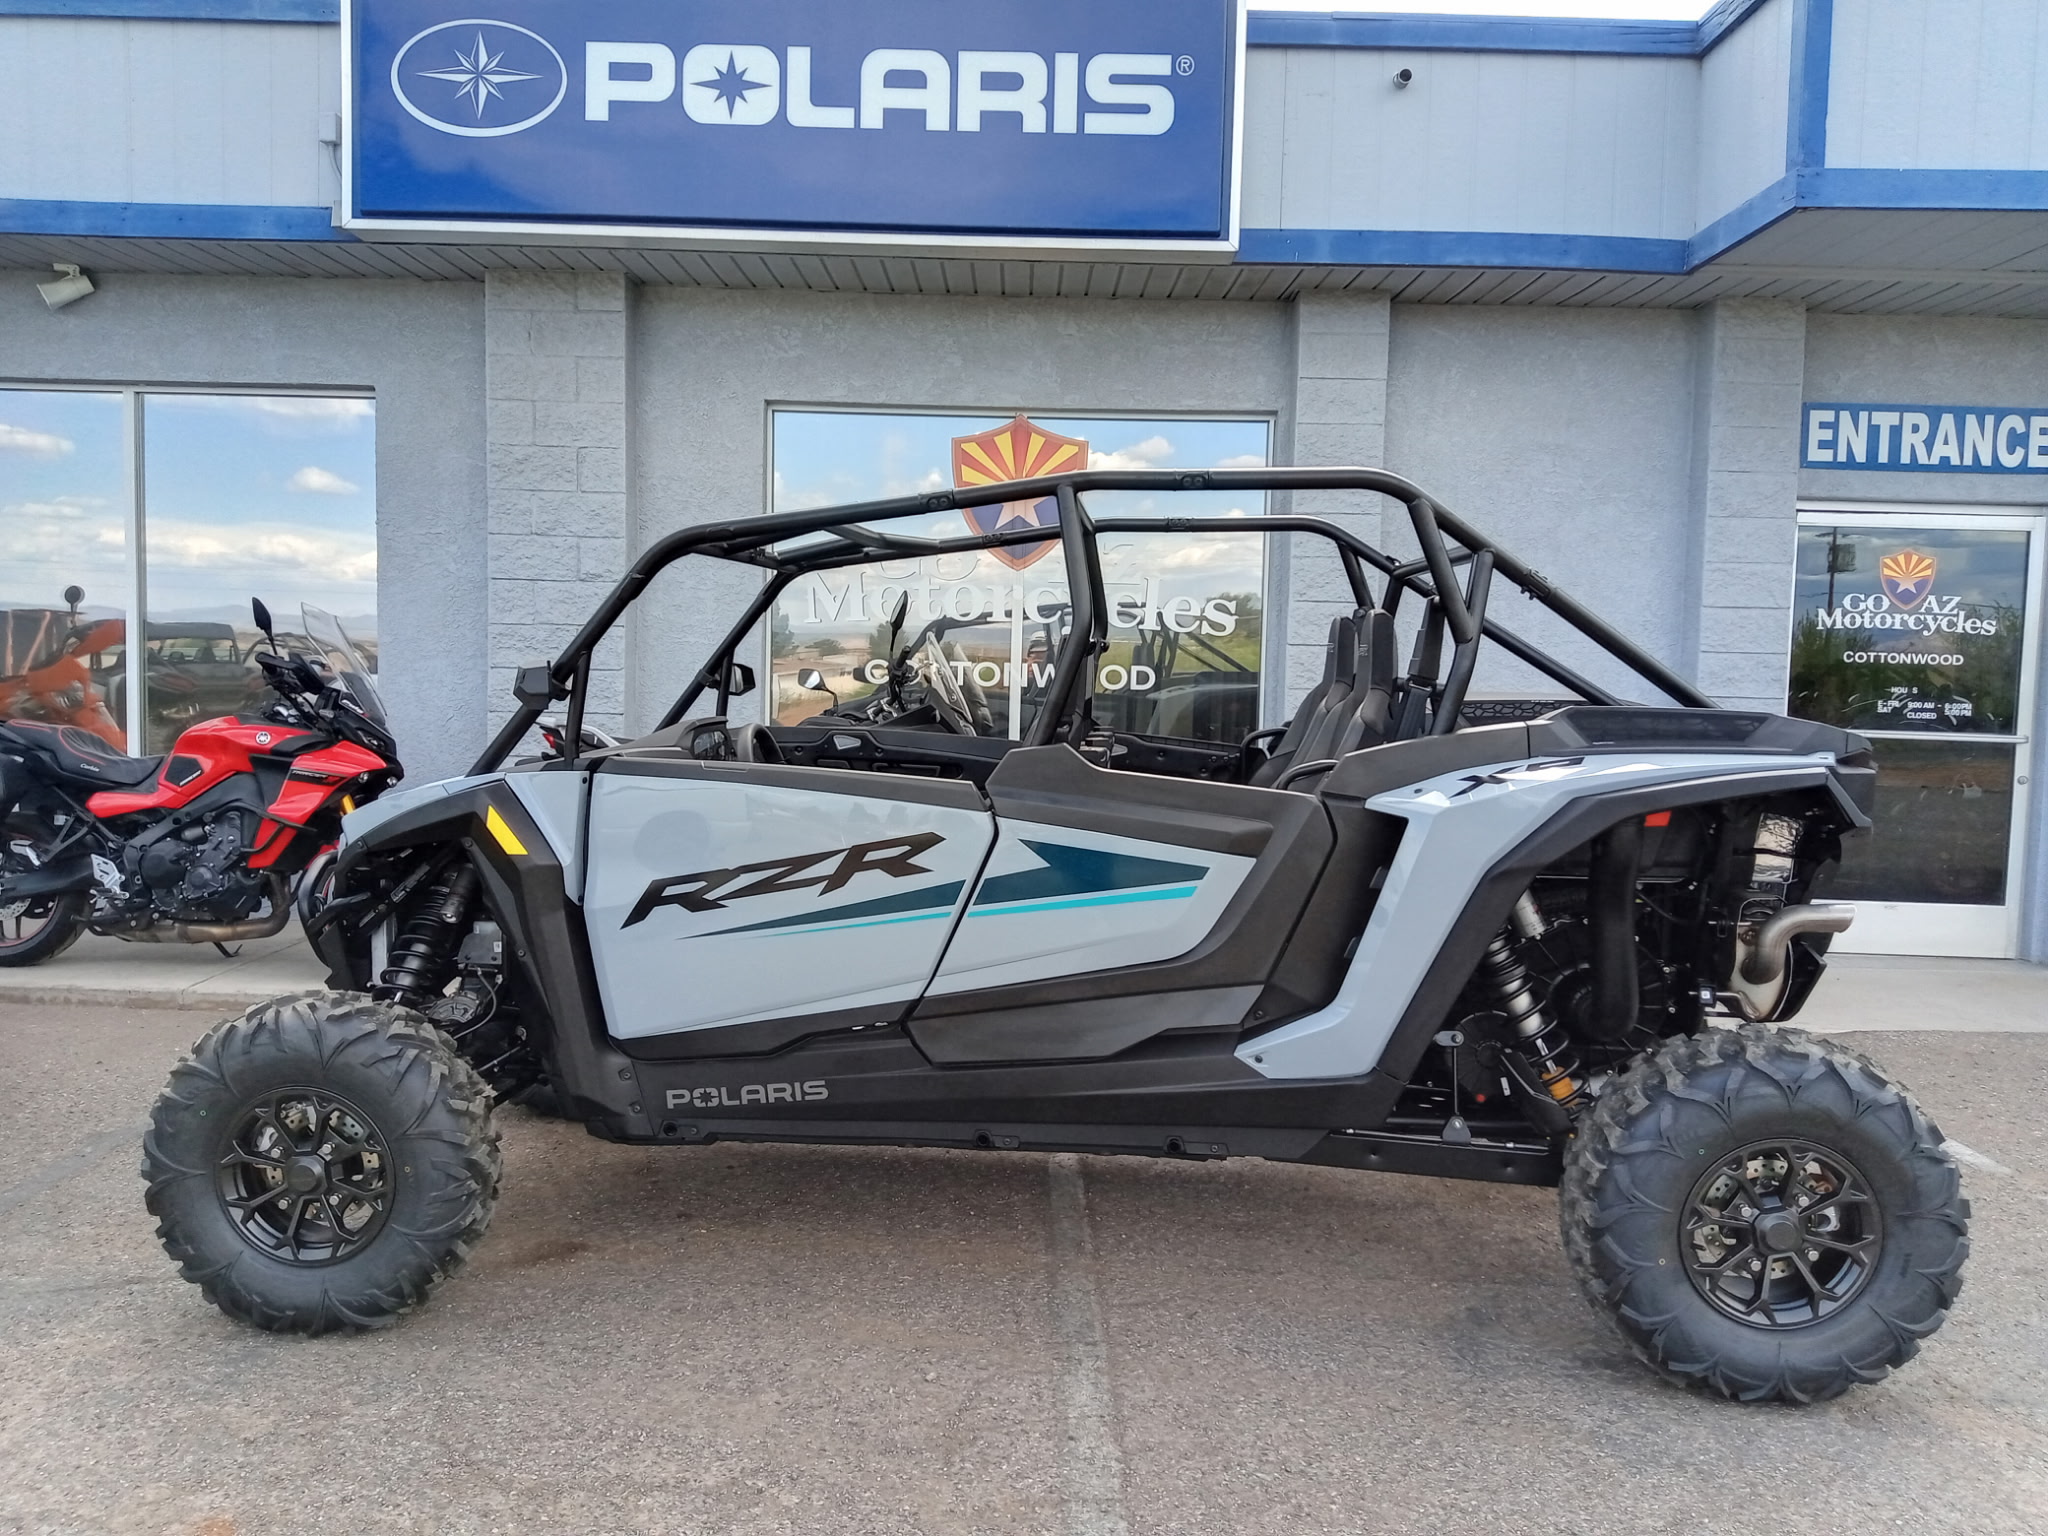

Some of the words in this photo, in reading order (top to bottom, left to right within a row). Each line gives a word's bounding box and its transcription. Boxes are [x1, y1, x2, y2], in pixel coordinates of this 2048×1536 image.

[1807, 409, 2048, 468] ENTRANCE
[1842, 593, 1890, 613] GO
[1919, 595, 1962, 615] AZ
[1816, 607, 1997, 636] Motorcycles
[1842, 651, 1964, 666] COTTONWOOD
[1890, 686, 1918, 694] HOUS
[1906, 711, 1937, 720] CLOSED
[619, 831, 947, 930] RZR
[665, 1080, 830, 1110] POLARIS
